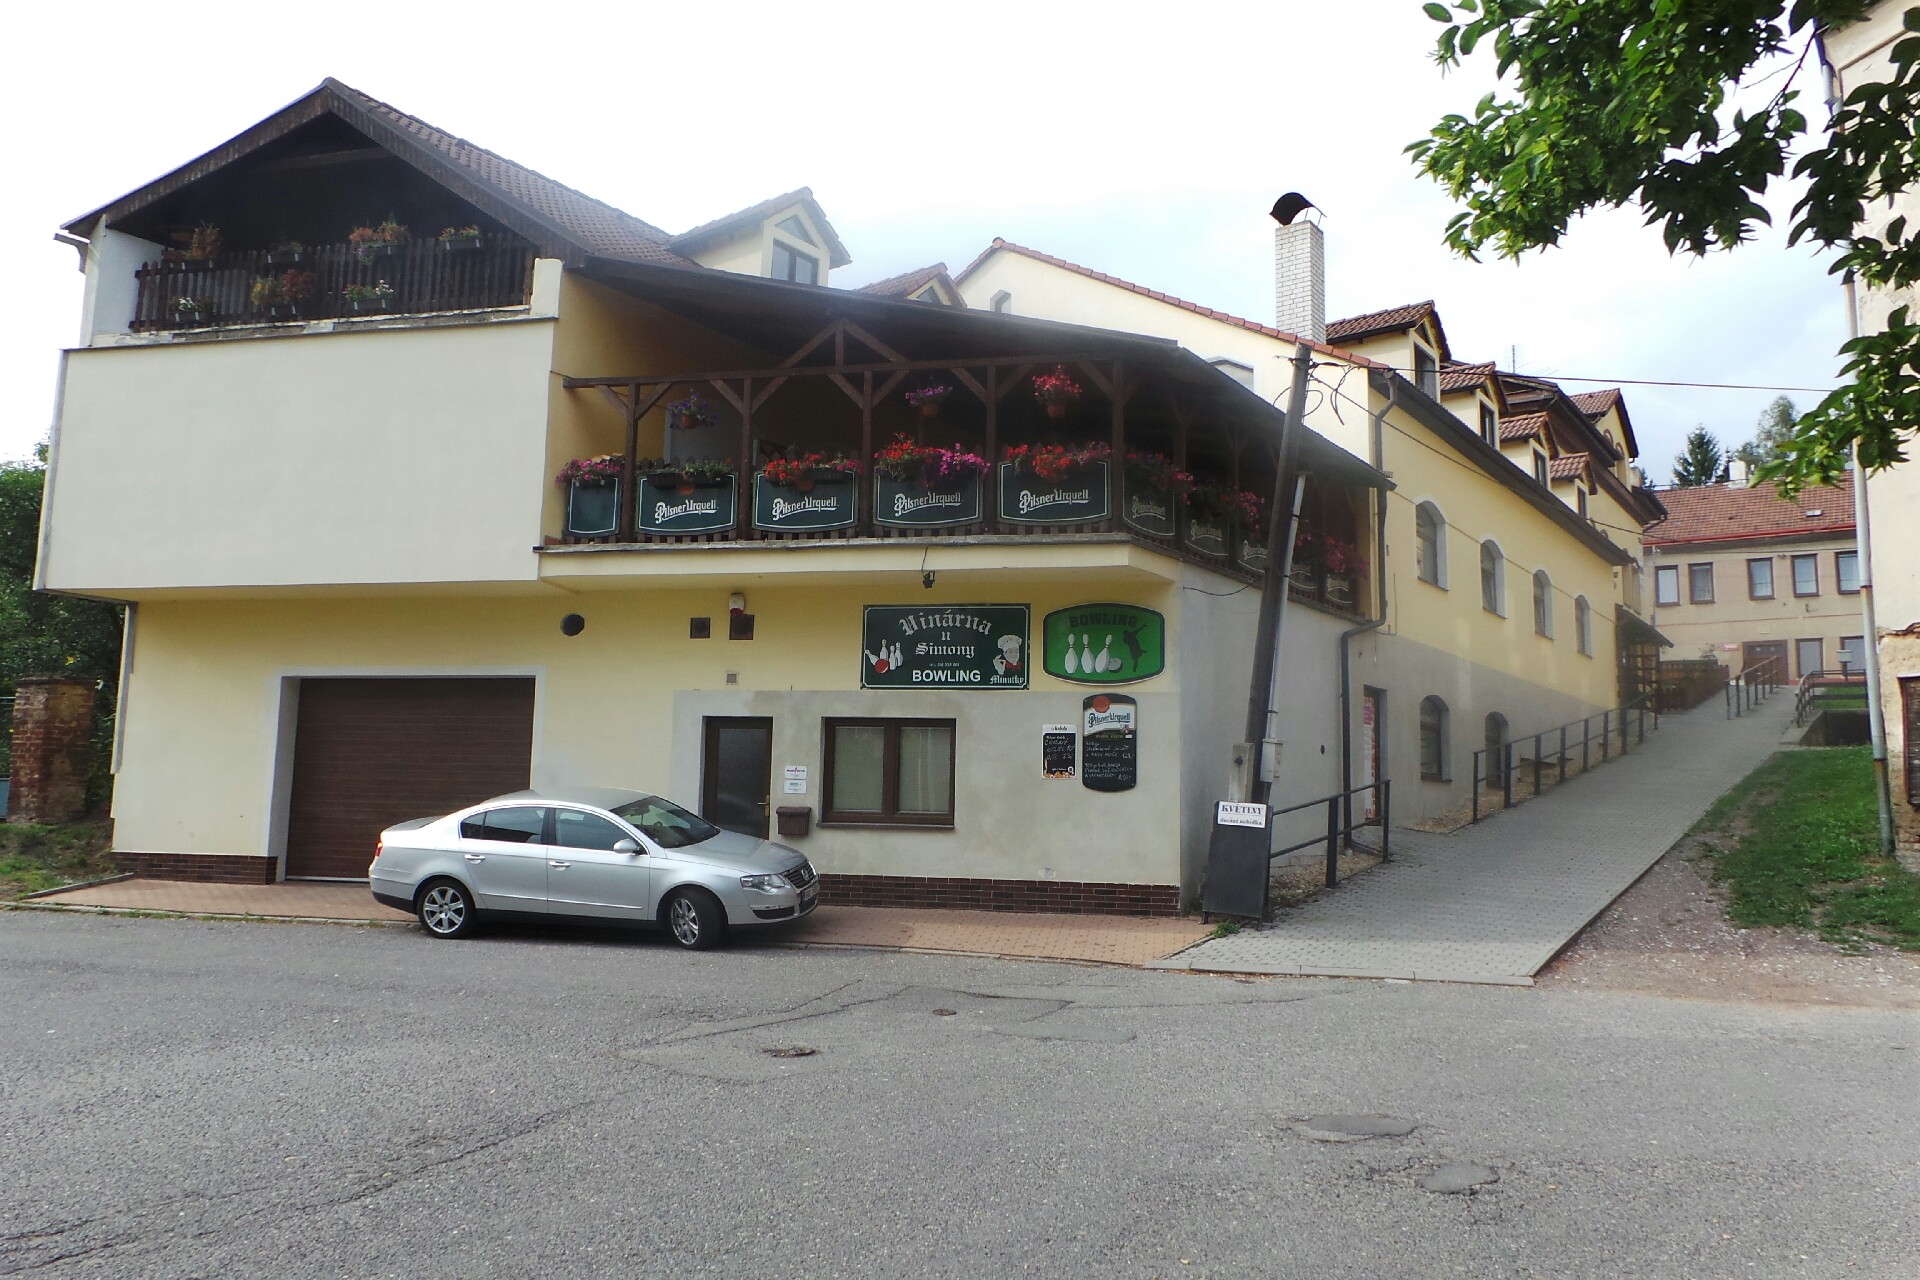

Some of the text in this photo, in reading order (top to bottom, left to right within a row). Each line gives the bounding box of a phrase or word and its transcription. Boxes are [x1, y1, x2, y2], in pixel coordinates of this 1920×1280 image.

[772, 496, 837, 521] Pilsner Urquell
[894, 491, 961, 517] Pilsner Urquell
[1019, 488, 1089, 514] Pilsner Urquell
[654, 499, 717, 524] Pilsner Urquell
[898, 609, 992, 636] Vinárna
[1068, 613, 1138, 628] BOWLING
[915, 642, 975, 659] Simony
[912, 670, 981, 682] BOWLING
[989, 674, 1025, 685] Minutky
[1088, 712, 1131, 728] Pilsner Urquell
[1221, 804, 1263, 814] KVĚTINY
